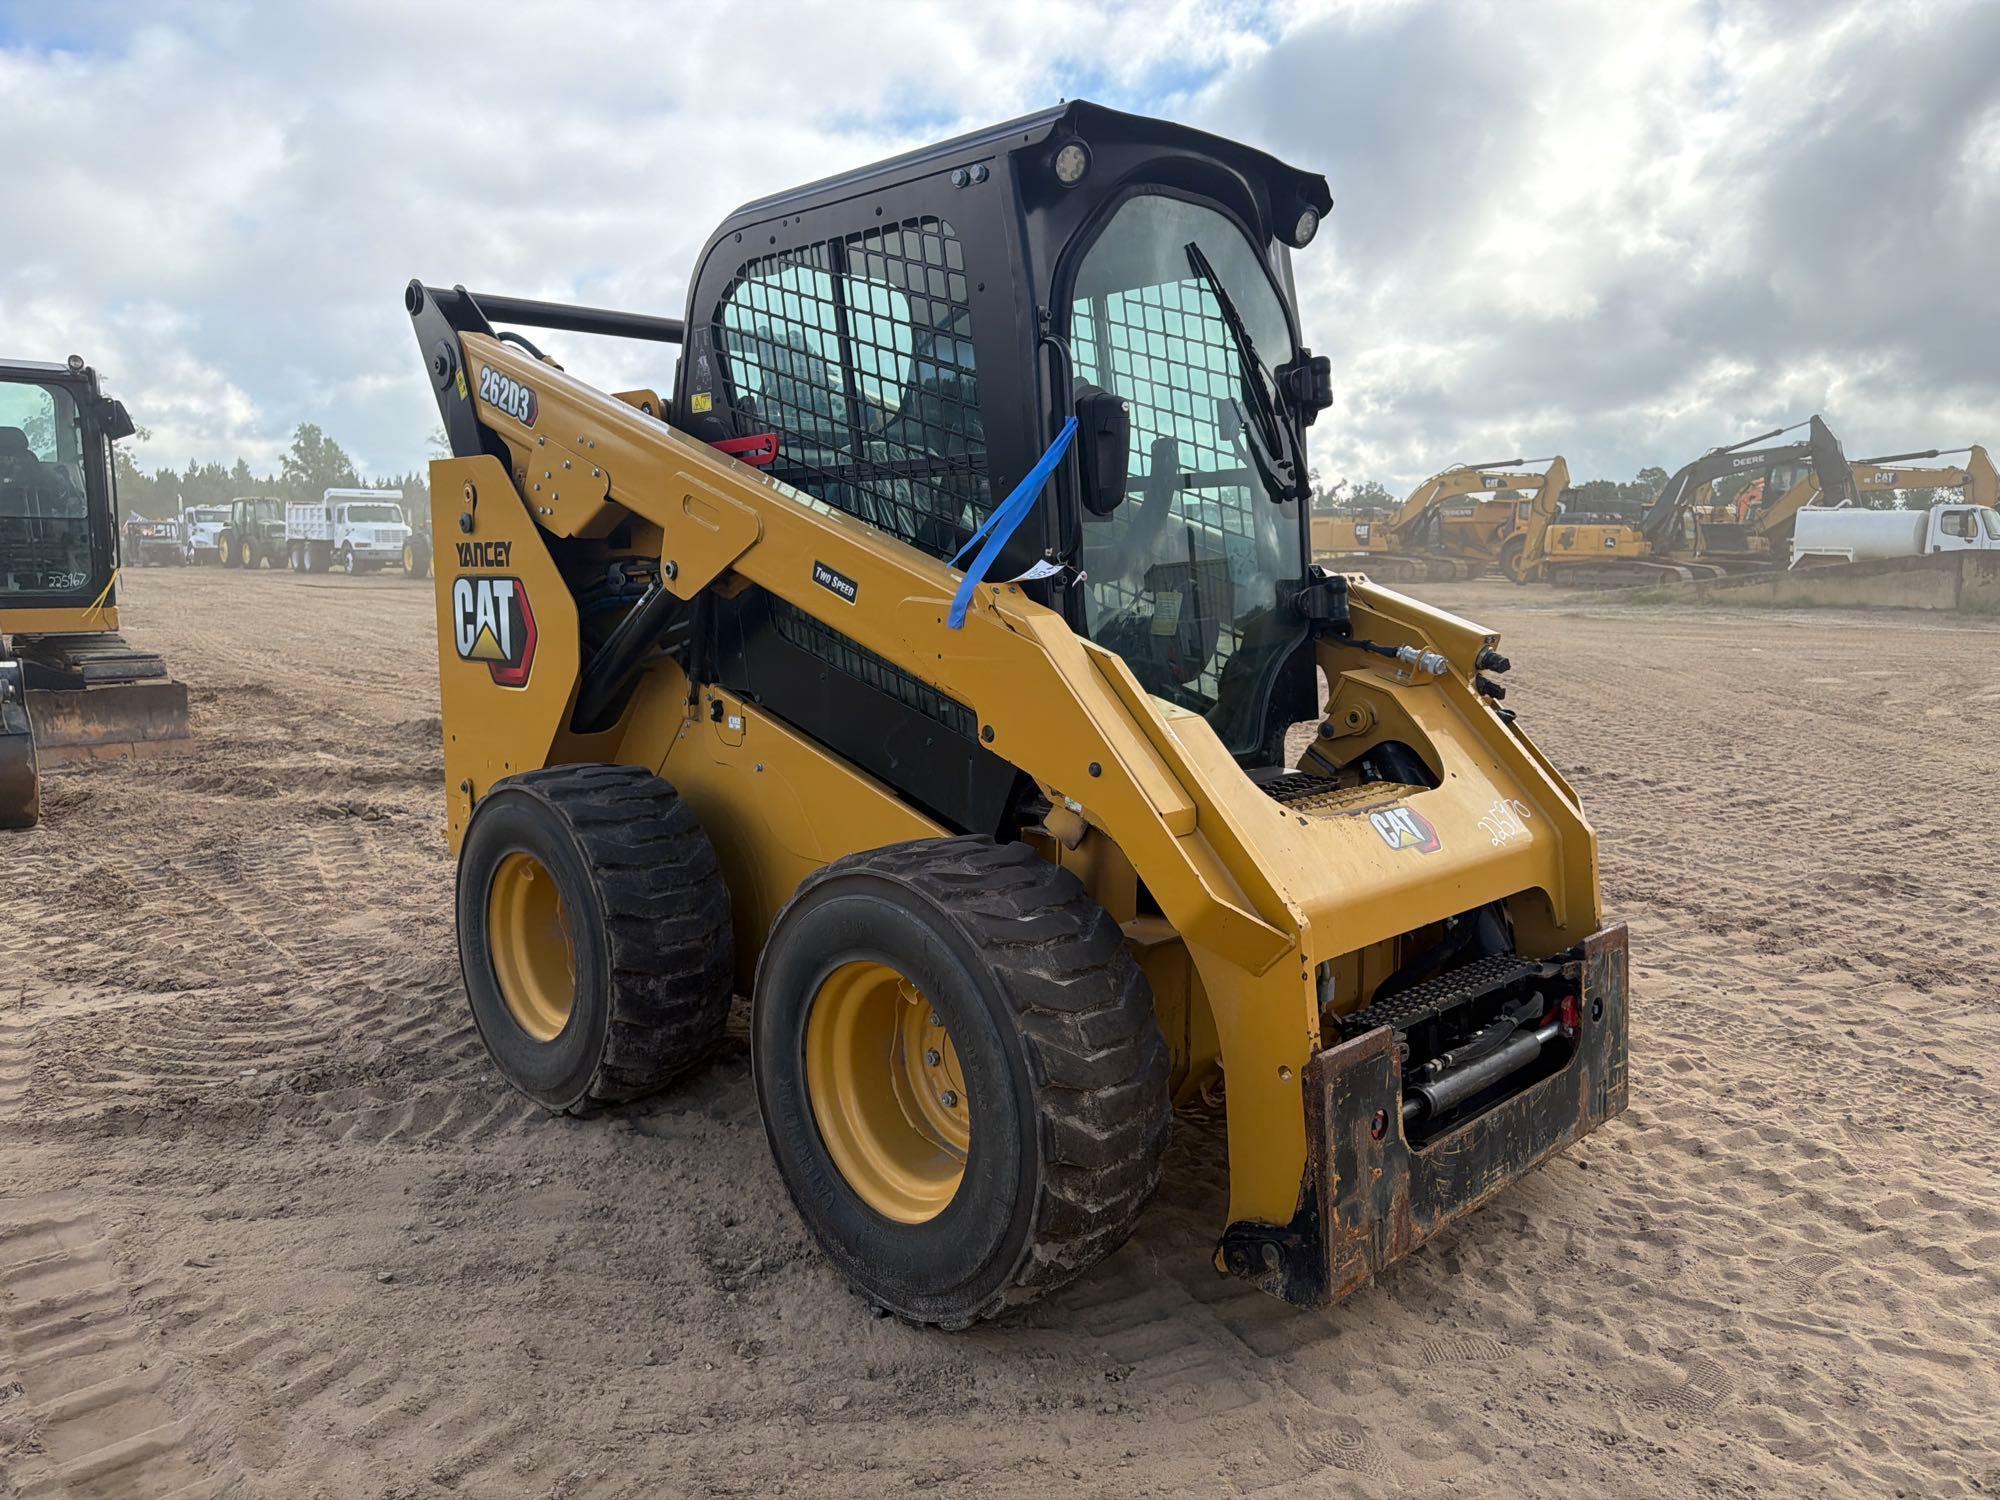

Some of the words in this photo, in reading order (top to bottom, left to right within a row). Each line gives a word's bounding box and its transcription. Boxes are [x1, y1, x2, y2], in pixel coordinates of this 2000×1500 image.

[480, 366, 529, 422] 262D3
[1732, 455, 1765, 467] DEERE
[1485, 479, 1498, 488] CAT
[1874, 472, 1895, 484] CAT
[1355, 525, 1369, 535] CAT
[456, 541, 512, 567] YANCEY
[48, 572, 87, 588] 225967
[453, 578, 514, 660] CAT
[1370, 807, 1426, 849] CAT
